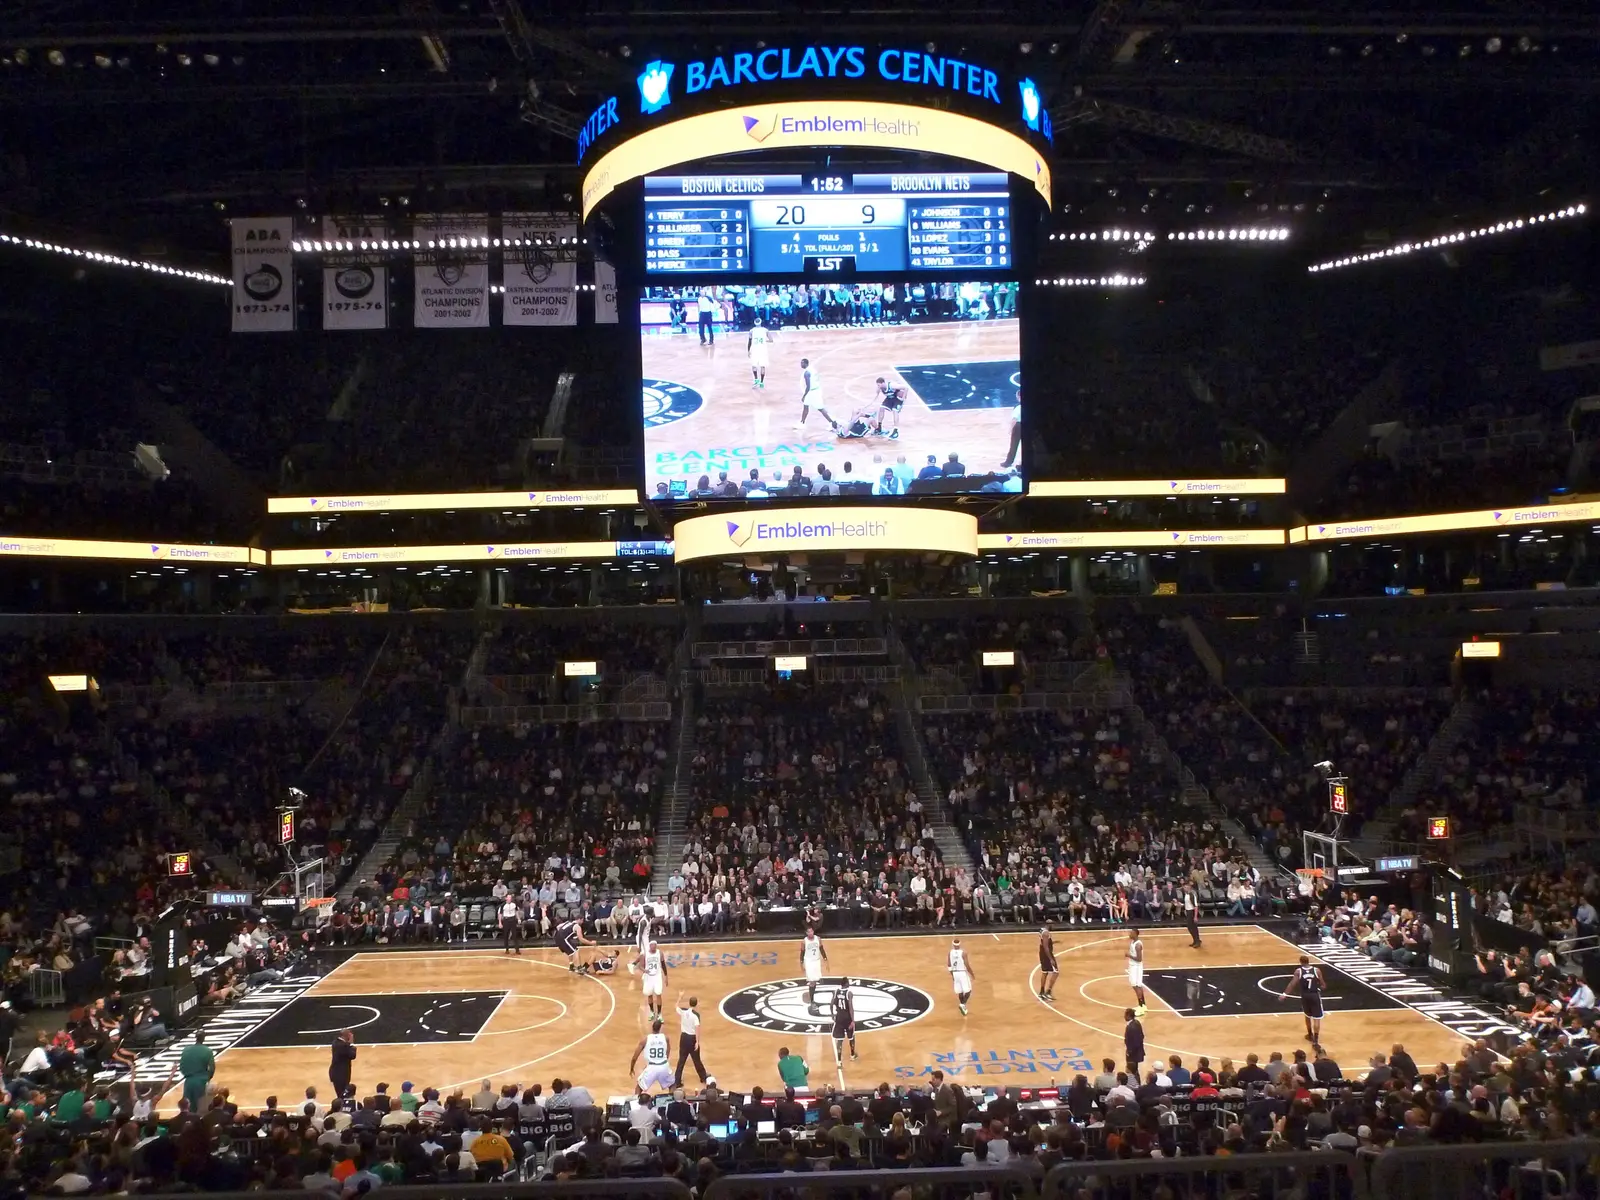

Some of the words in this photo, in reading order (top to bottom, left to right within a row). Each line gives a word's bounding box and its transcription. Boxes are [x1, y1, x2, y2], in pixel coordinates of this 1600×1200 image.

[687, 47, 865, 93] BARCLAYS
[878, 50, 1001, 103] CENTER
[782, 116, 919, 136] EmblemHealth
[682, 179, 722, 193] BOSTON
[725, 178, 765, 192] CELTICS
[811, 177, 843, 191] 1:52
[891, 176, 942, 191] BROOKLYN
[945, 176, 970, 190] NETS
[657, 211, 685, 220] TERRY
[721, 210, 728, 219] 0
[735, 210, 742, 219] 0
[776, 205, 805, 225] 20
[862, 204, 875, 224] 9
[912, 209, 918, 217] 7
[921, 208, 960, 217] JOHNSON
[983, 207, 990, 216] 0
[721, 224, 728, 232] 2
[736, 224, 742, 232] 2
[921, 221, 961, 230] WILLIAMS
[984, 221, 991, 230] 0
[998, 221, 1005, 229] 1
[246, 229, 280, 241] ABA
[338, 227, 372, 238] ABA
[523, 231, 556, 243] NETS
[793, 232, 800, 241] 4
[859, 232, 866, 241] 1
[922, 234, 948, 242] LOPEZ
[999, 233, 1006, 242] 0
[657, 249, 680, 258] BASS
[721, 249, 728, 257] 2
[736, 248, 743, 257] 0
[781, 244, 800, 253] 5/1
[860, 243, 879, 252] 5/1
[922, 246, 950, 255] EVANS
[999, 245, 1006, 254] 0
[658, 261, 686, 269] PIERCE
[737, 260, 743, 269] 1
[817, 258, 843, 270] 1ST
[923, 257, 954, 266] TAYLOR
[985, 257, 992, 265] 0
[1000, 256, 1007, 265] 0
[454, 287, 483, 295] DIVISION
[328, 302, 382, 311] 1975-76
[424, 298, 480, 308] CHAMPIONS
[512, 296, 568, 306] CHAMPIONS
[236, 304, 290, 313] 1973-74
[434, 309, 471, 318] 2001-2002
[521, 308, 559, 316] 2001-2002
[656, 442, 835, 464] BARCLAYS
[656, 455, 805, 475] CENTER
[757, 520, 886, 539] EmblemHealth
[1388, 859, 1401, 868] NBA
[1402, 858, 1412, 867] TV
[220, 894, 235, 903] NBA
[236, 894, 246, 903] TV
[1298, 943, 1442, 995] BROOKLYN
[1306, 978, 1312, 989] 7
[838, 998, 846, 1010] 41
[736, 1008, 921, 1033] BROKLYN
[1408, 1001, 1521, 1037] NETS
[649, 1047, 664, 1059] 98
[930, 1047, 1084, 1063] CENTER
[894, 1059, 1094, 1078] BARCLAYS
